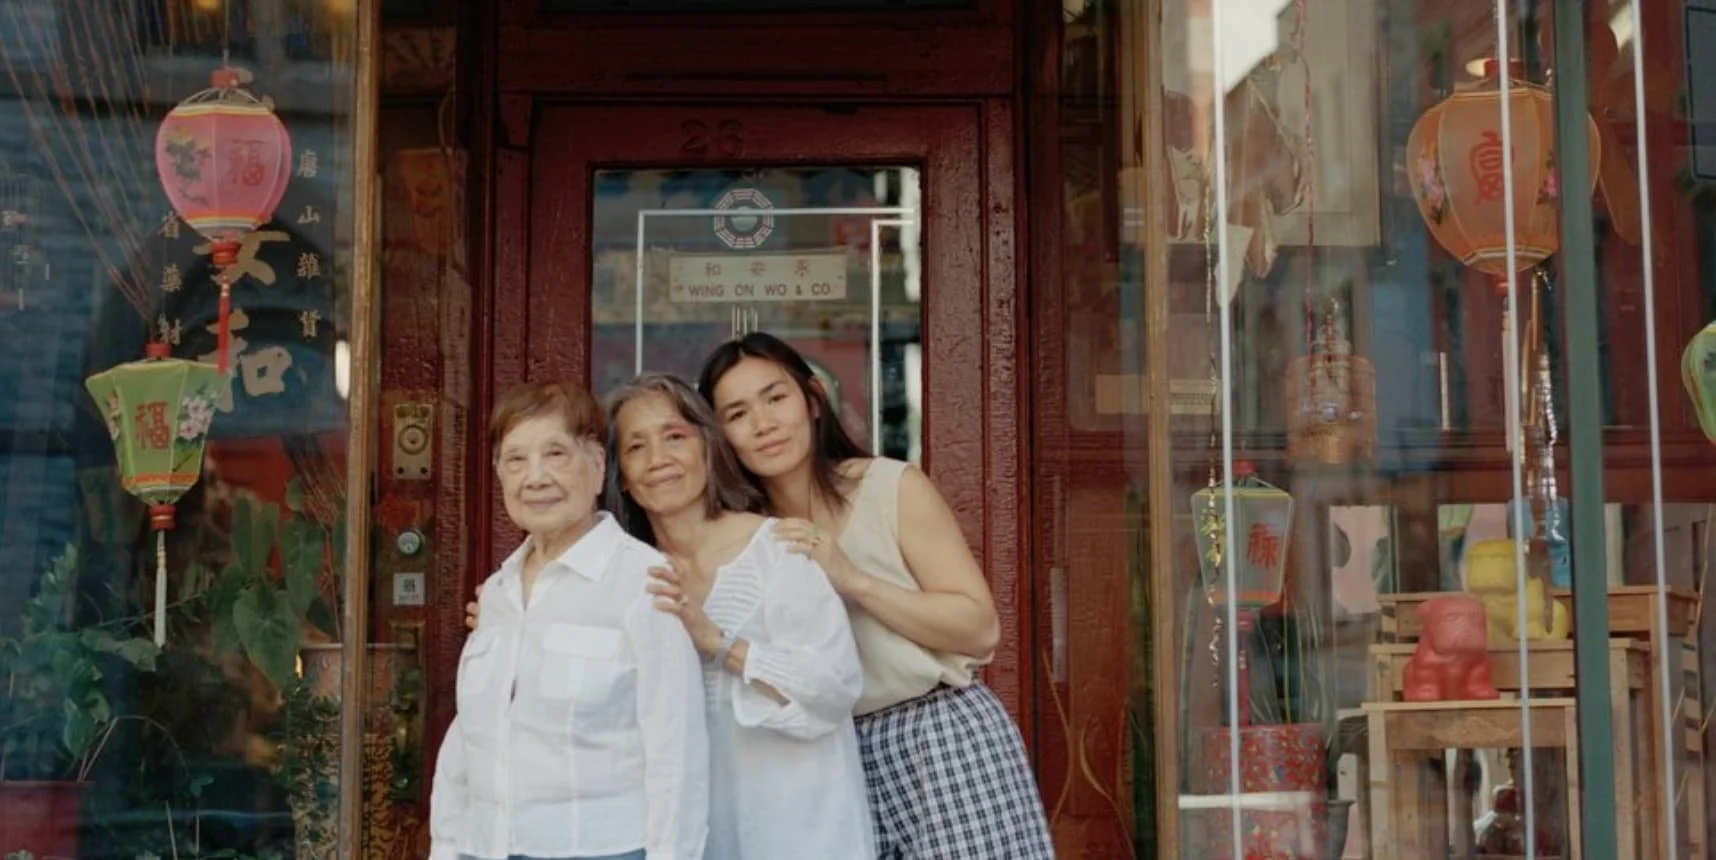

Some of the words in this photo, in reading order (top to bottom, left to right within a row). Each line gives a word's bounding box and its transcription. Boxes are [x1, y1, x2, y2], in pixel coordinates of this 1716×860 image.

[680, 118, 744, 158] 26
[227, 138, 267, 186] 福
[688, 284, 725, 297] WING
[734, 284, 755, 297] ON
[765, 283, 787, 296] WO
[811, 282, 831, 296] CO
[134, 400, 169, 451] 福
